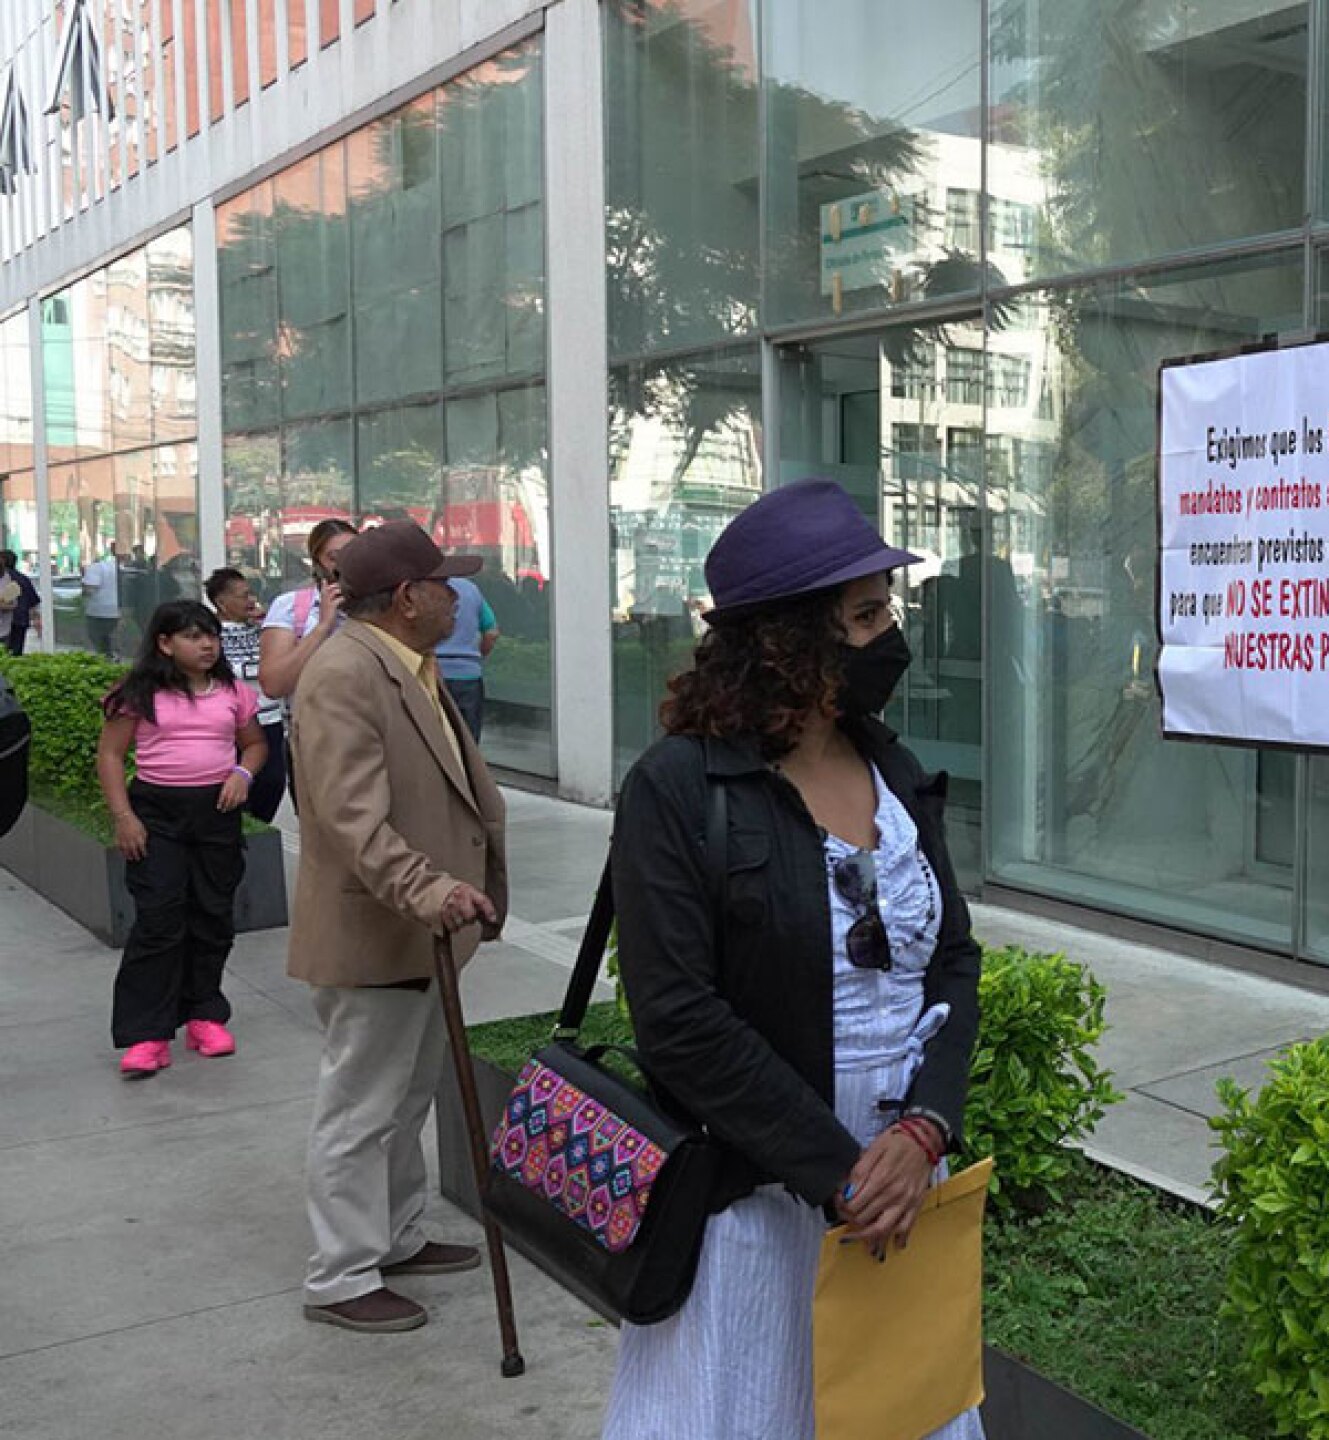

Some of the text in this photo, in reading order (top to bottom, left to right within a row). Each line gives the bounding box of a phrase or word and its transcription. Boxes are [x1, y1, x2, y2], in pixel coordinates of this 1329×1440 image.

[1207, 426, 1266, 469] Exigimos
[1270, 430, 1296, 465] que
[1302, 416, 1323, 454] los
[1180, 479, 1242, 515] mandatos
[1247, 488, 1254, 518] y
[1256, 476, 1321, 511] contratos
[1258, 527, 1324, 574] previstos
[1170, 591, 1196, 625] para
[1203, 591, 1223, 625] que
[1226, 580, 1245, 620] NO
[1250, 578, 1272, 618] SE
[1224, 631, 1313, 673] NUESTRAS
